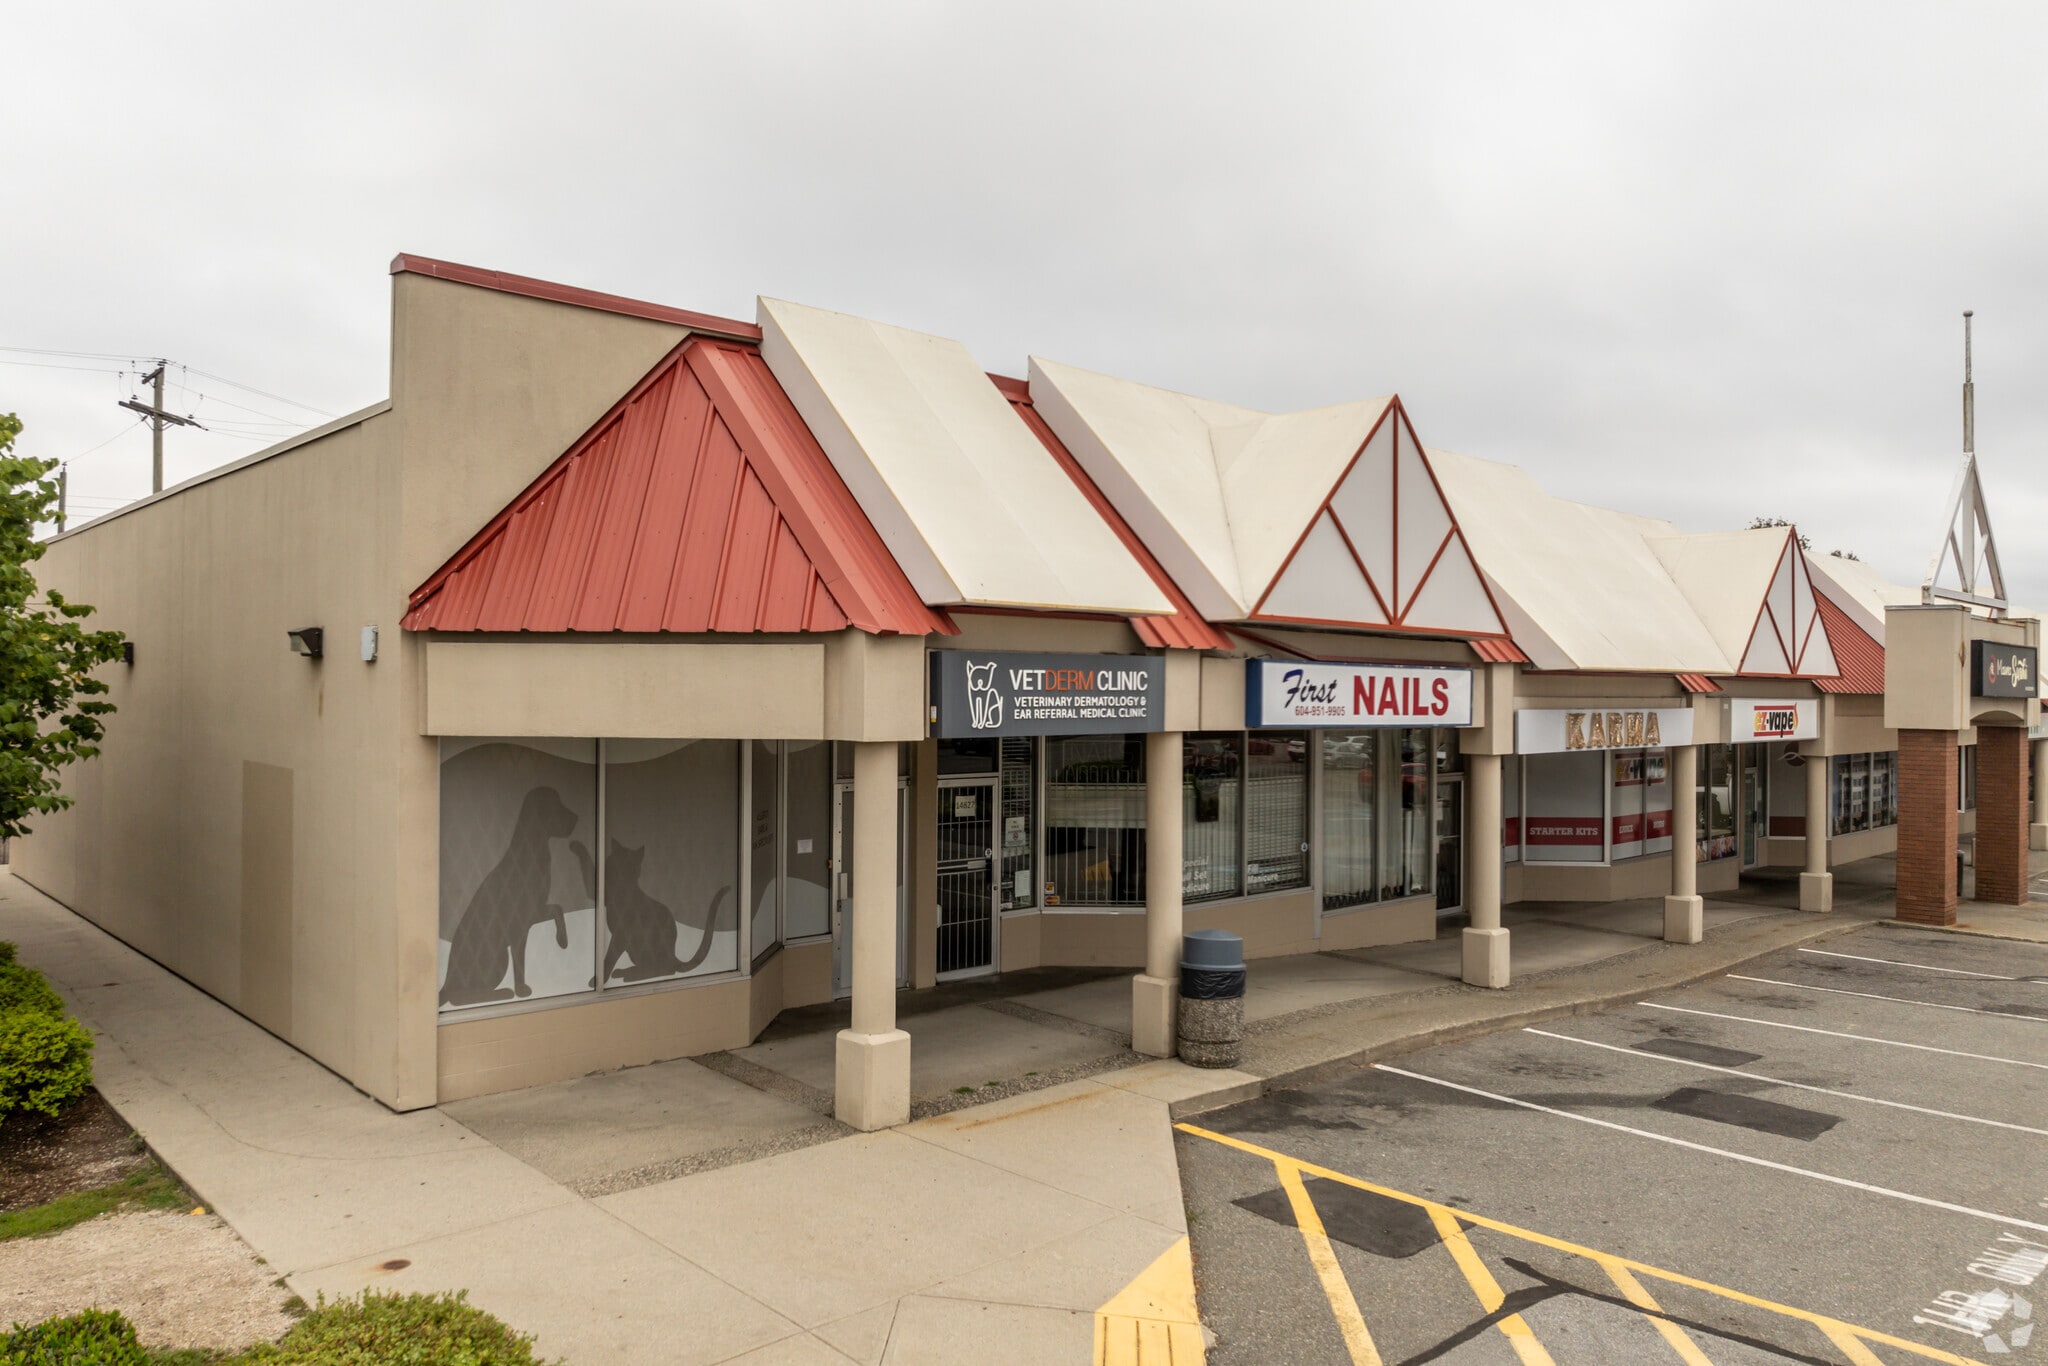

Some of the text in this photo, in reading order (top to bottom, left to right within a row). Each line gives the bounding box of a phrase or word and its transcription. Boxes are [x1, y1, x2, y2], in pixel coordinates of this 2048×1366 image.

[1009, 669, 1148, 691] VETDERM CLINIC
[1282, 669, 1450, 717] First NAILS
[1014, 697, 1146, 707] VETERINARY DERMATOLOGY &
[1014, 708, 1147, 719] EAR REFERRAL MEDICAL CLINIC
[1295, 705, 1346, 716] 604-951-9905
[1565, 712, 1661, 749] KARMA
[1529, 827, 1599, 836] STARTER KITS
[1182, 856, 1209, 868] pecial
[1182, 882, 1209, 894] edicure
